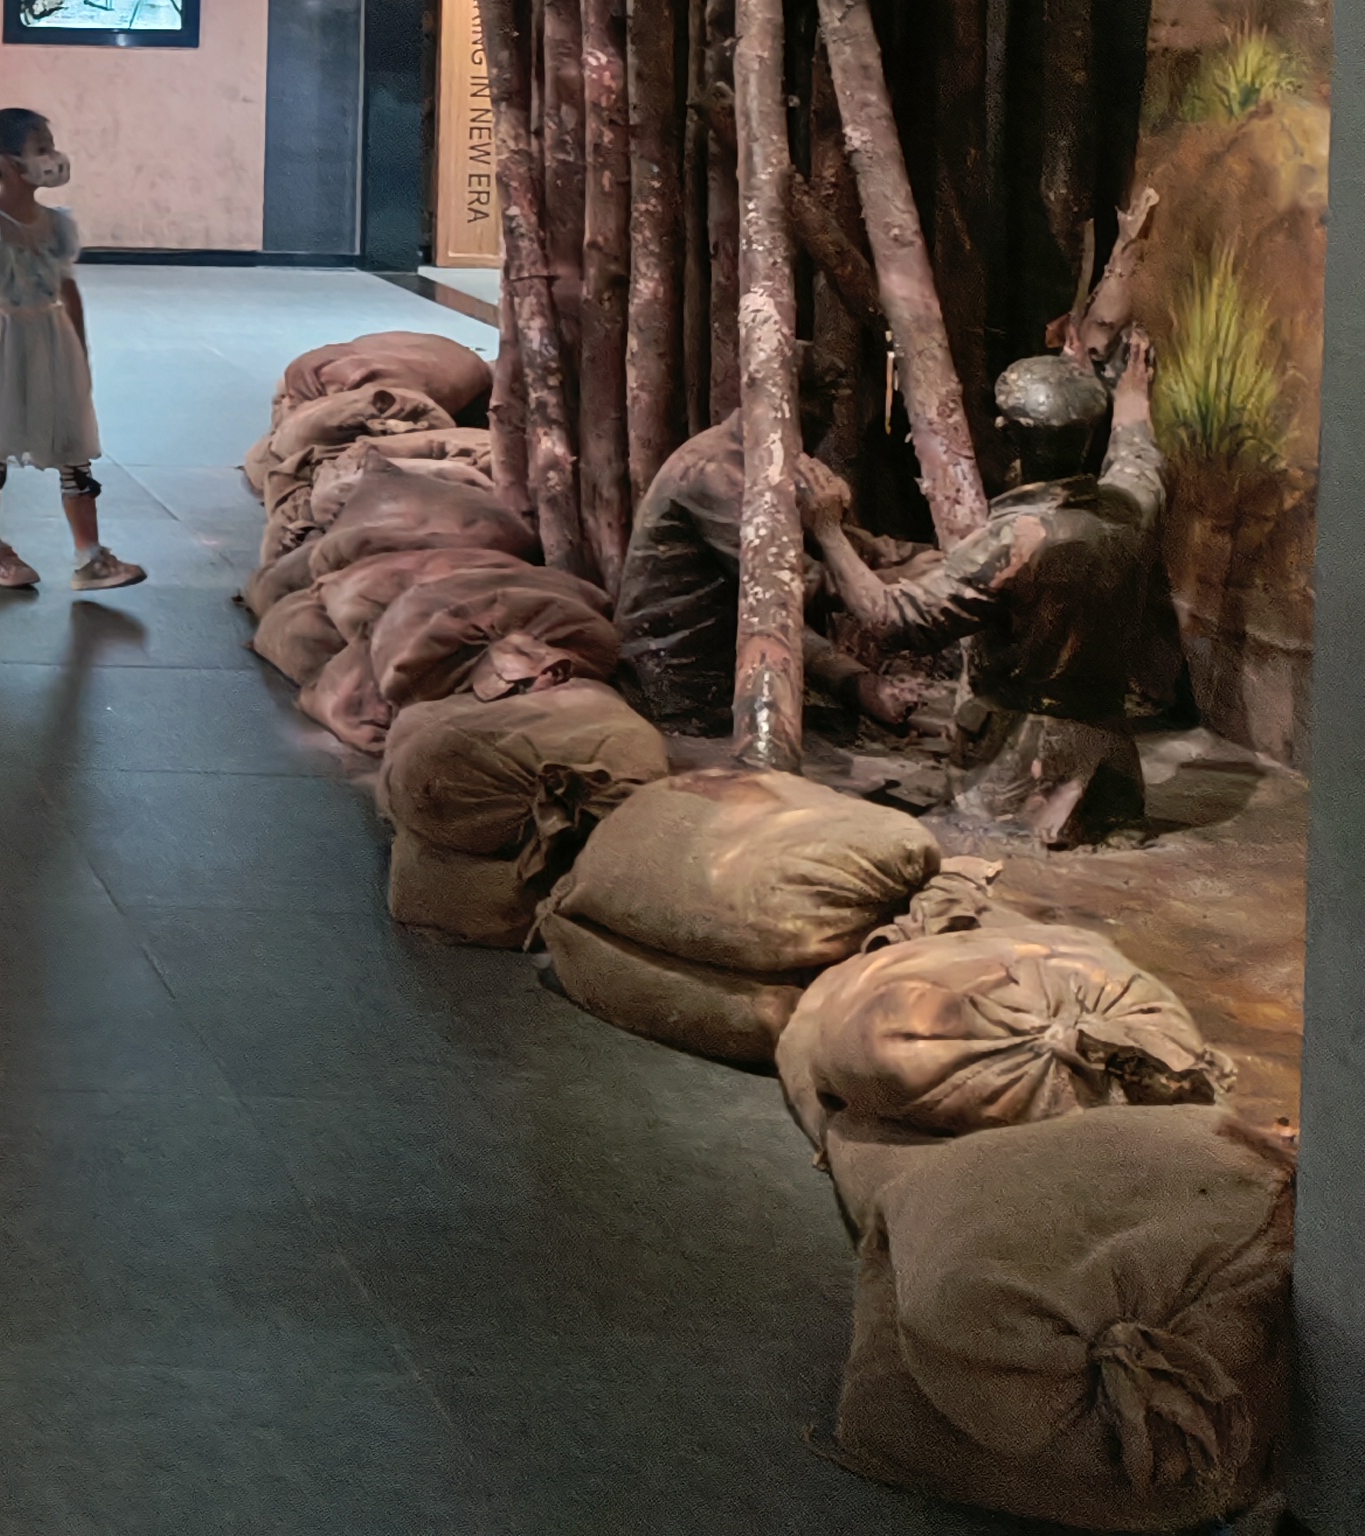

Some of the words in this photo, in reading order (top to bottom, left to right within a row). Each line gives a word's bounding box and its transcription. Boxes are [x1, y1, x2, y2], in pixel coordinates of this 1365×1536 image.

[469, 75, 491, 98] IN
[468, 107, 493, 165] NEW
[466, 173, 491, 224] ERA
